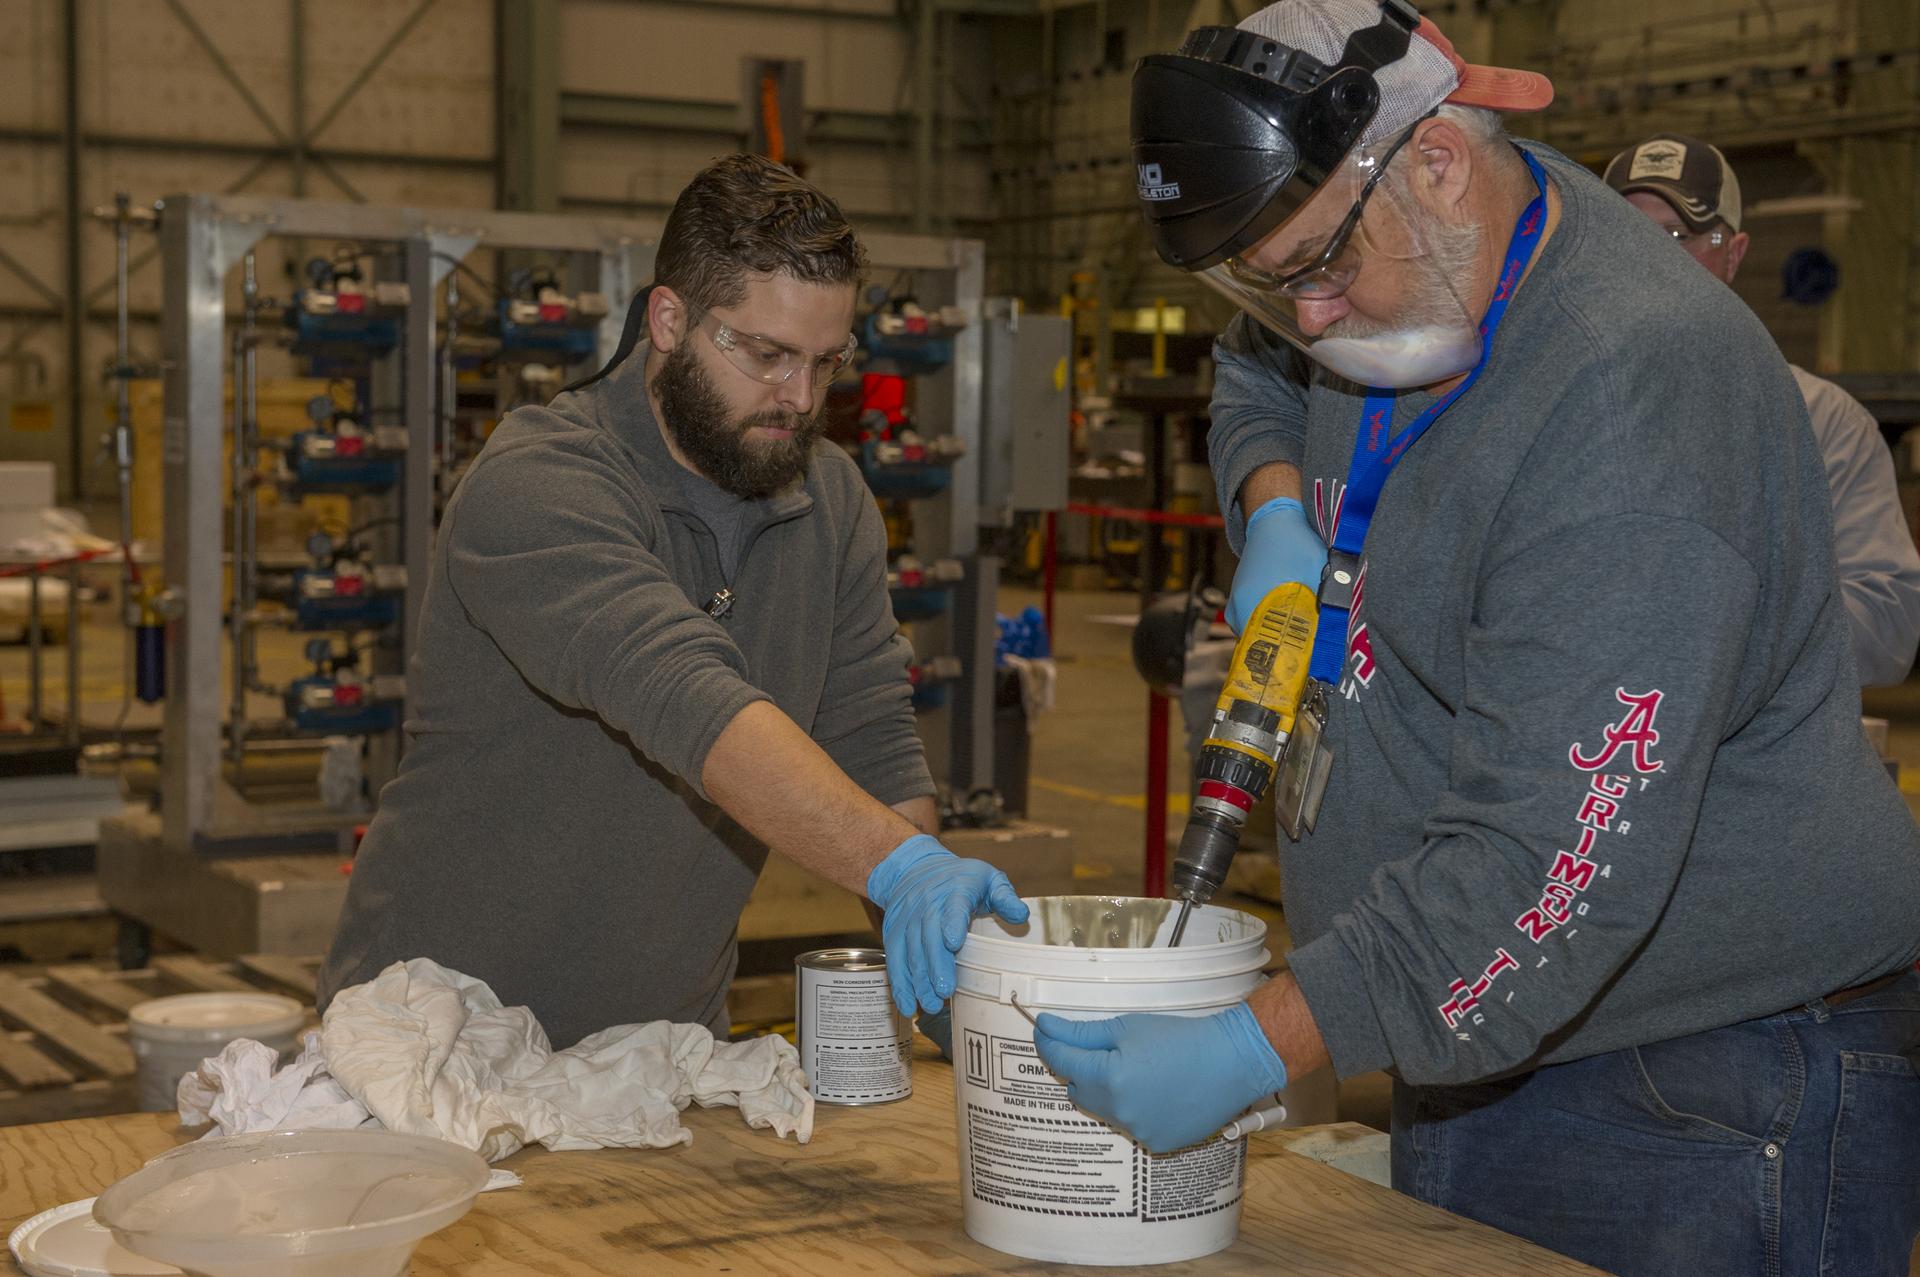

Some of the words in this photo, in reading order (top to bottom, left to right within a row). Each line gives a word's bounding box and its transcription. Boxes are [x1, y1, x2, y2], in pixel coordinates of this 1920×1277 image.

[1569, 686, 1665, 773] A
[999, 1042, 1035, 1053] CONSUMER
[1004, 1097, 1026, 1108] MADE
[1028, 1099, 1036, 1108] IN
[1038, 1100, 1055, 1110] THE
[1058, 1101, 1077, 1111] USA
